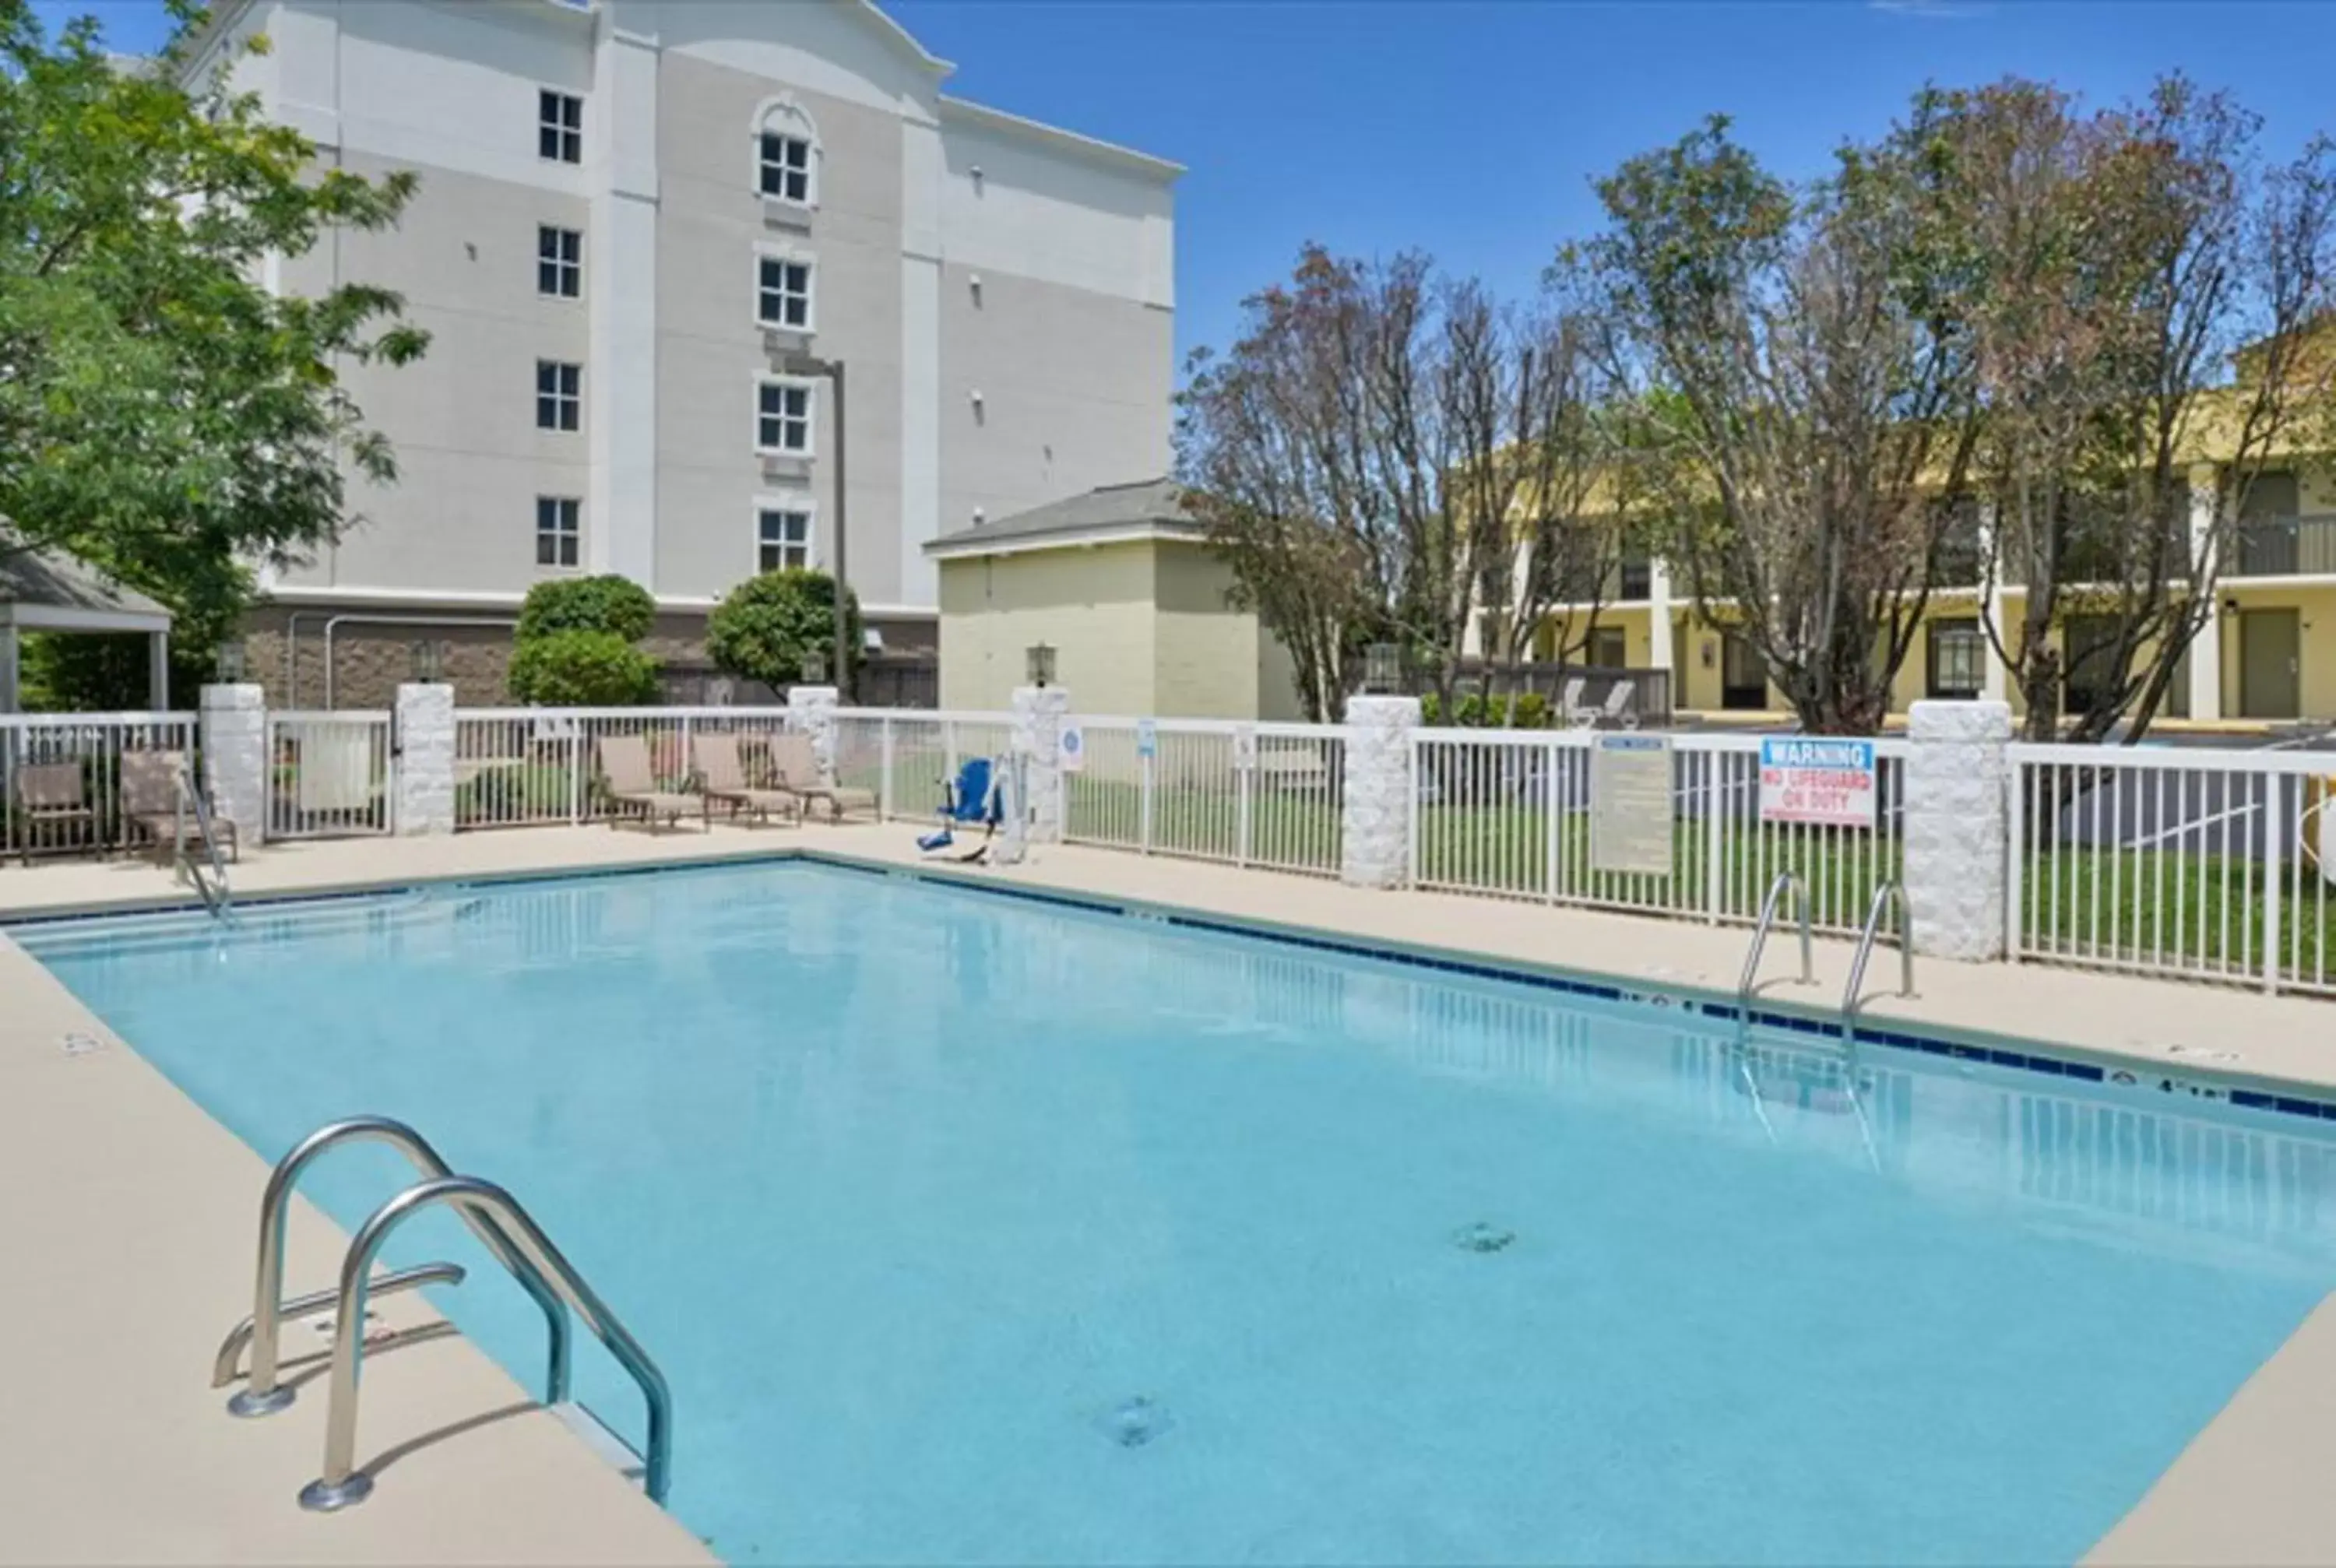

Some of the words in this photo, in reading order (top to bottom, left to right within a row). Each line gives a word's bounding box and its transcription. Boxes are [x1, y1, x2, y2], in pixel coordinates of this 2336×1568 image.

[1771, 741, 1864, 767] WARNING
[1763, 770, 1783, 786] NO
[1789, 770, 1870, 791] LIFEGUARD
[1782, 789, 1804, 808] ON
[1810, 789, 1851, 811] DUTY
